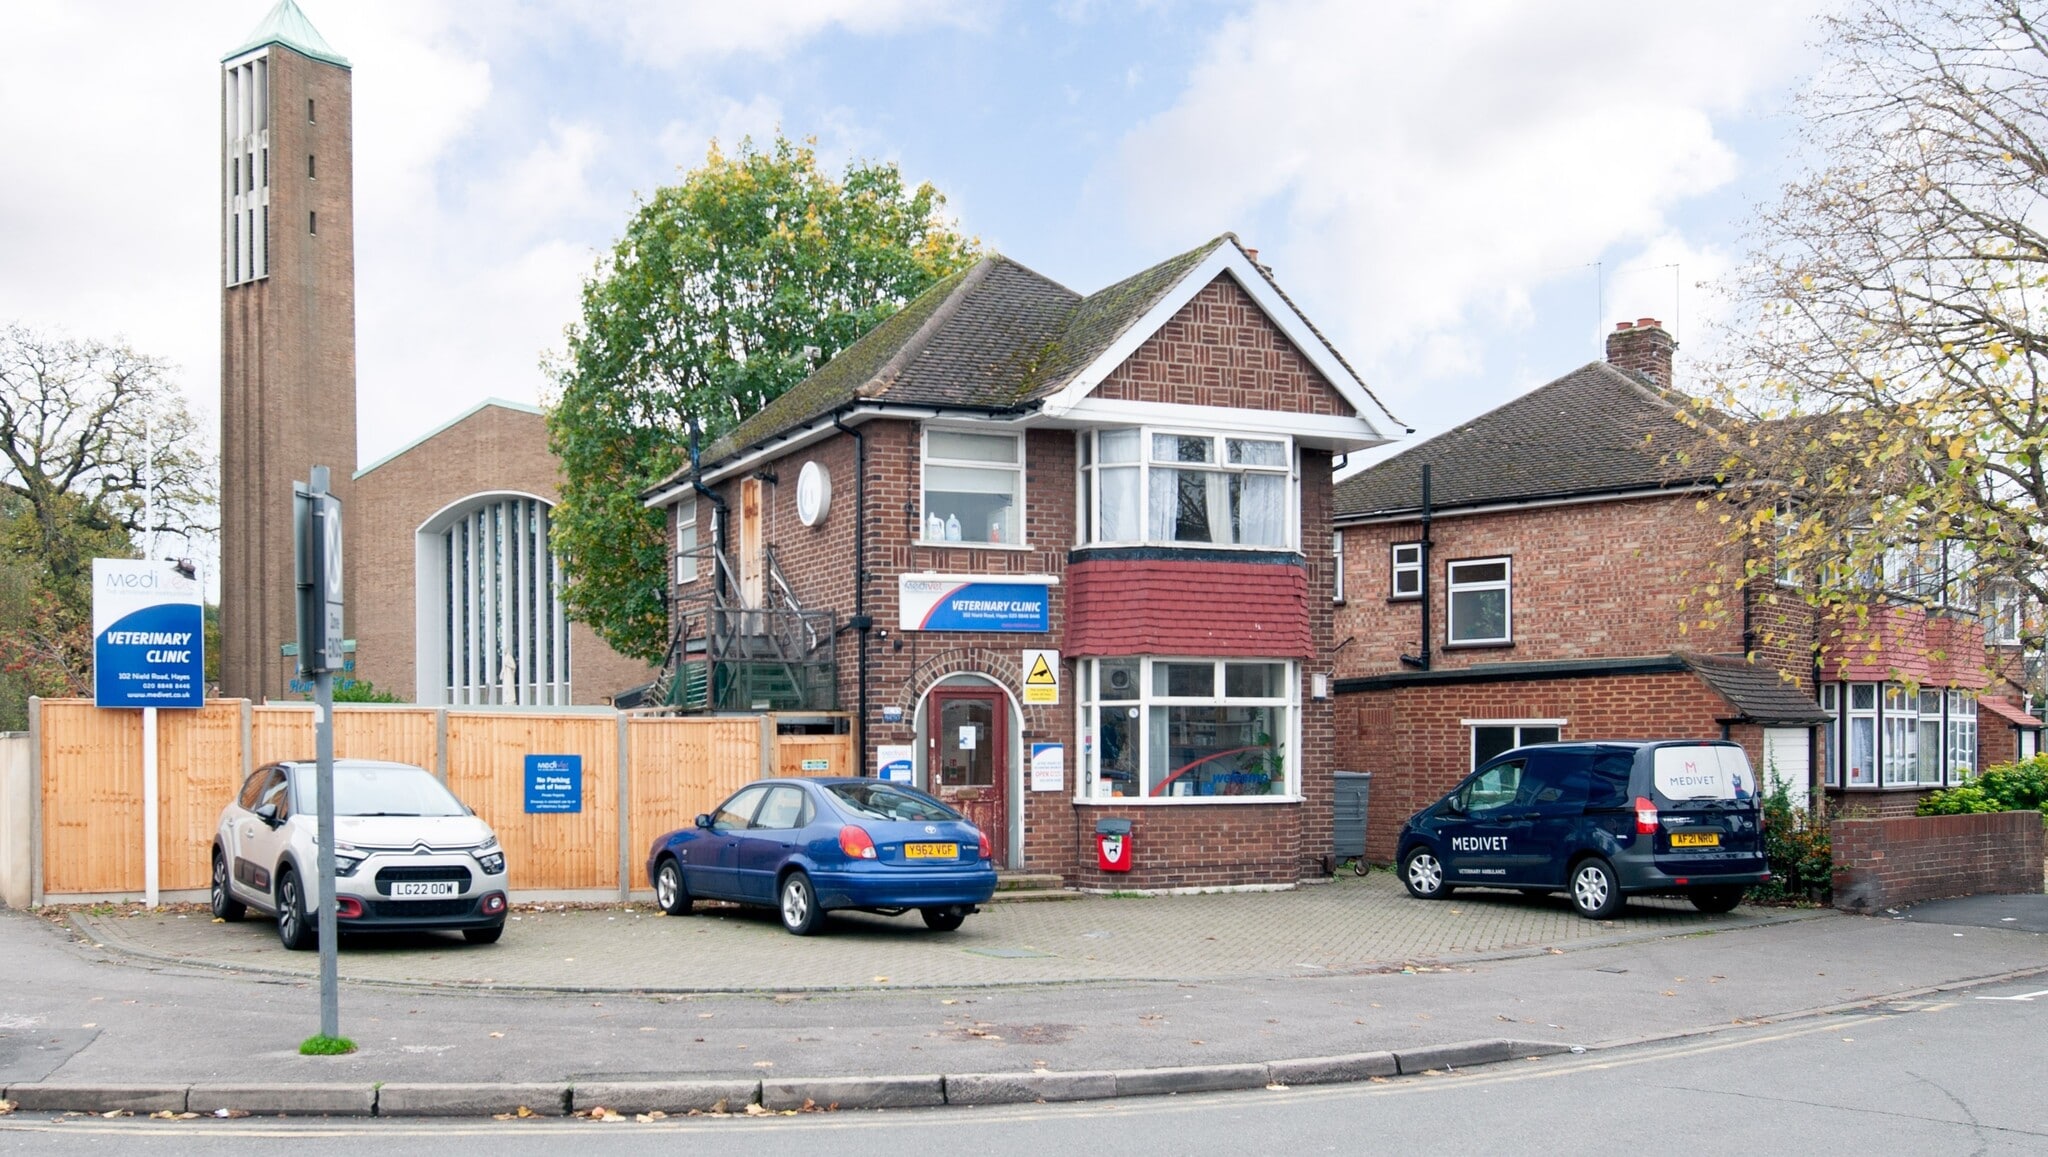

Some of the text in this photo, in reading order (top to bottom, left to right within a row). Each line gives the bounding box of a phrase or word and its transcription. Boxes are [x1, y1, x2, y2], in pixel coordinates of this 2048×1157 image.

[952, 600, 1042, 612] VETERINARY CLINIC
[107, 631, 192, 646] VETERINARY
[146, 650, 192, 663] CLINIC
[170, 673, 191, 681] Hayes
[1685, 761, 1697, 773] M
[536, 776, 571, 785] No Parking
[1212, 770, 1269, 785] welcome
[1669, 775, 1714, 786] MEDIVET
[1452, 836, 1508, 851] MEDIVET
[1678, 833, 1697, 844] AF21
[909, 845, 934, 855] Y962
[935, 845, 953, 855] VGF
[397, 883, 428, 895] LG22
